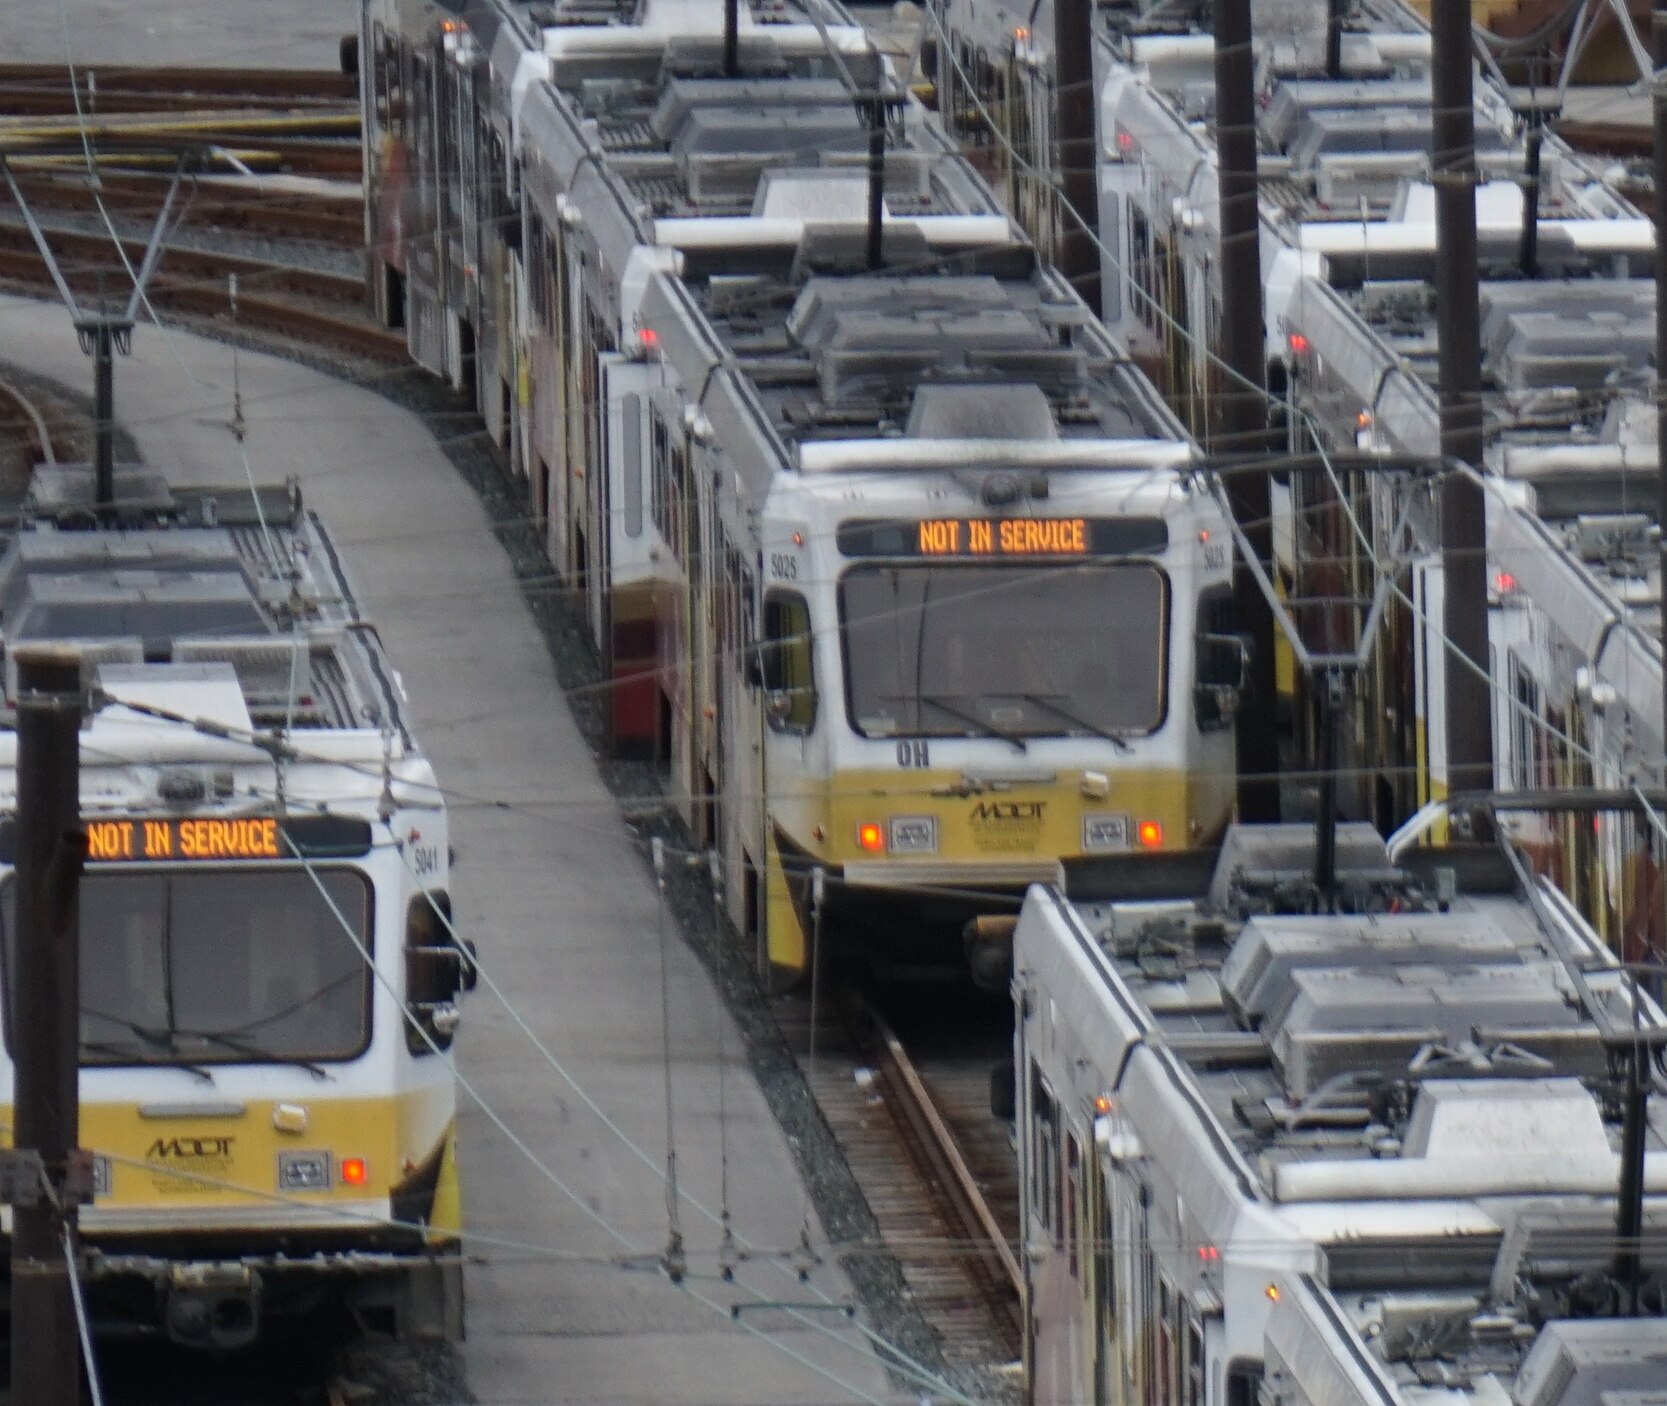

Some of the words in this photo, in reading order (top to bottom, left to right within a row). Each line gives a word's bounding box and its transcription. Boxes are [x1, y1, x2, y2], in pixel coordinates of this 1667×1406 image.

[919, 519, 960, 553] NOT
[968, 519, 993, 553] IN
[999, 518, 1086, 553] SERVICE
[896, 738, 930, 768] OH
[87, 820, 134, 858] NOT
[143, 820, 172, 857] IN
[178, 818, 278, 857] SERVICE
